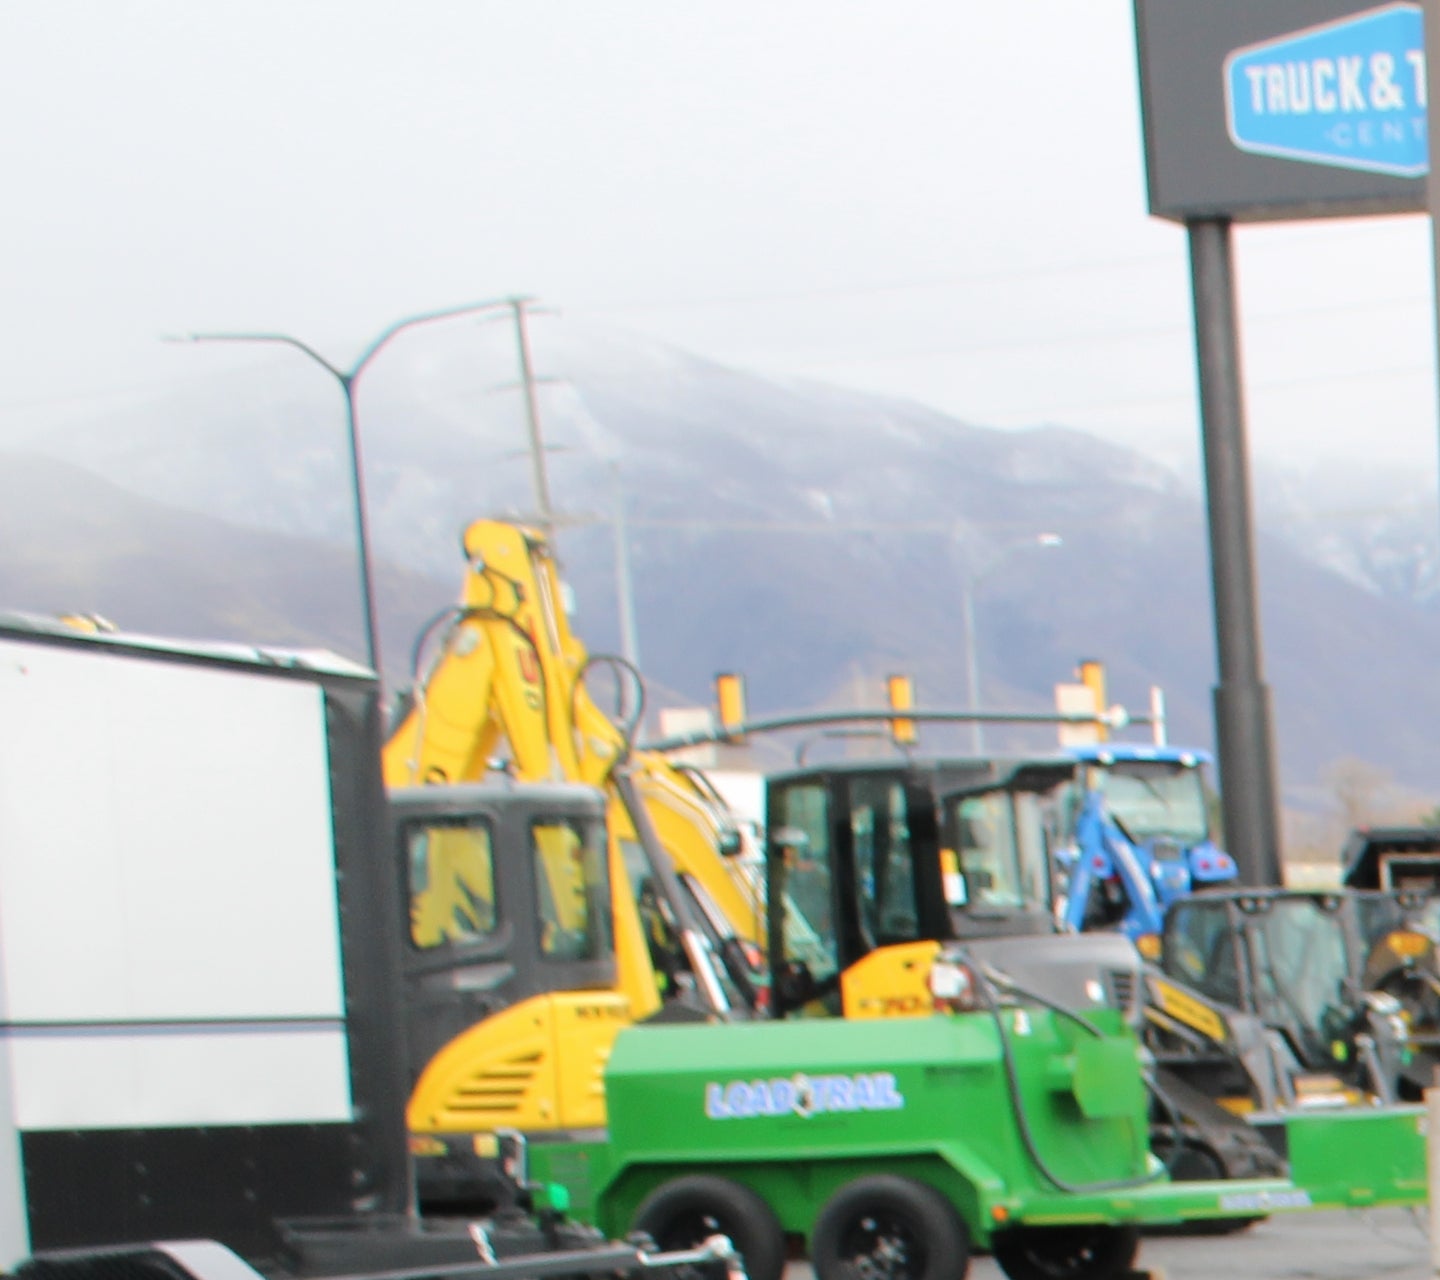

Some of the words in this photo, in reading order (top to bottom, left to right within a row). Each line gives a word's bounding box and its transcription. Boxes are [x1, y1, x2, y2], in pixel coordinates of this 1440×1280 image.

[1244, 56, 1366, 115] TRUCK
[1370, 52, 1405, 111] &
[705, 1078, 797, 1119] LOAD
[808, 1073, 904, 1113] TRAIL
